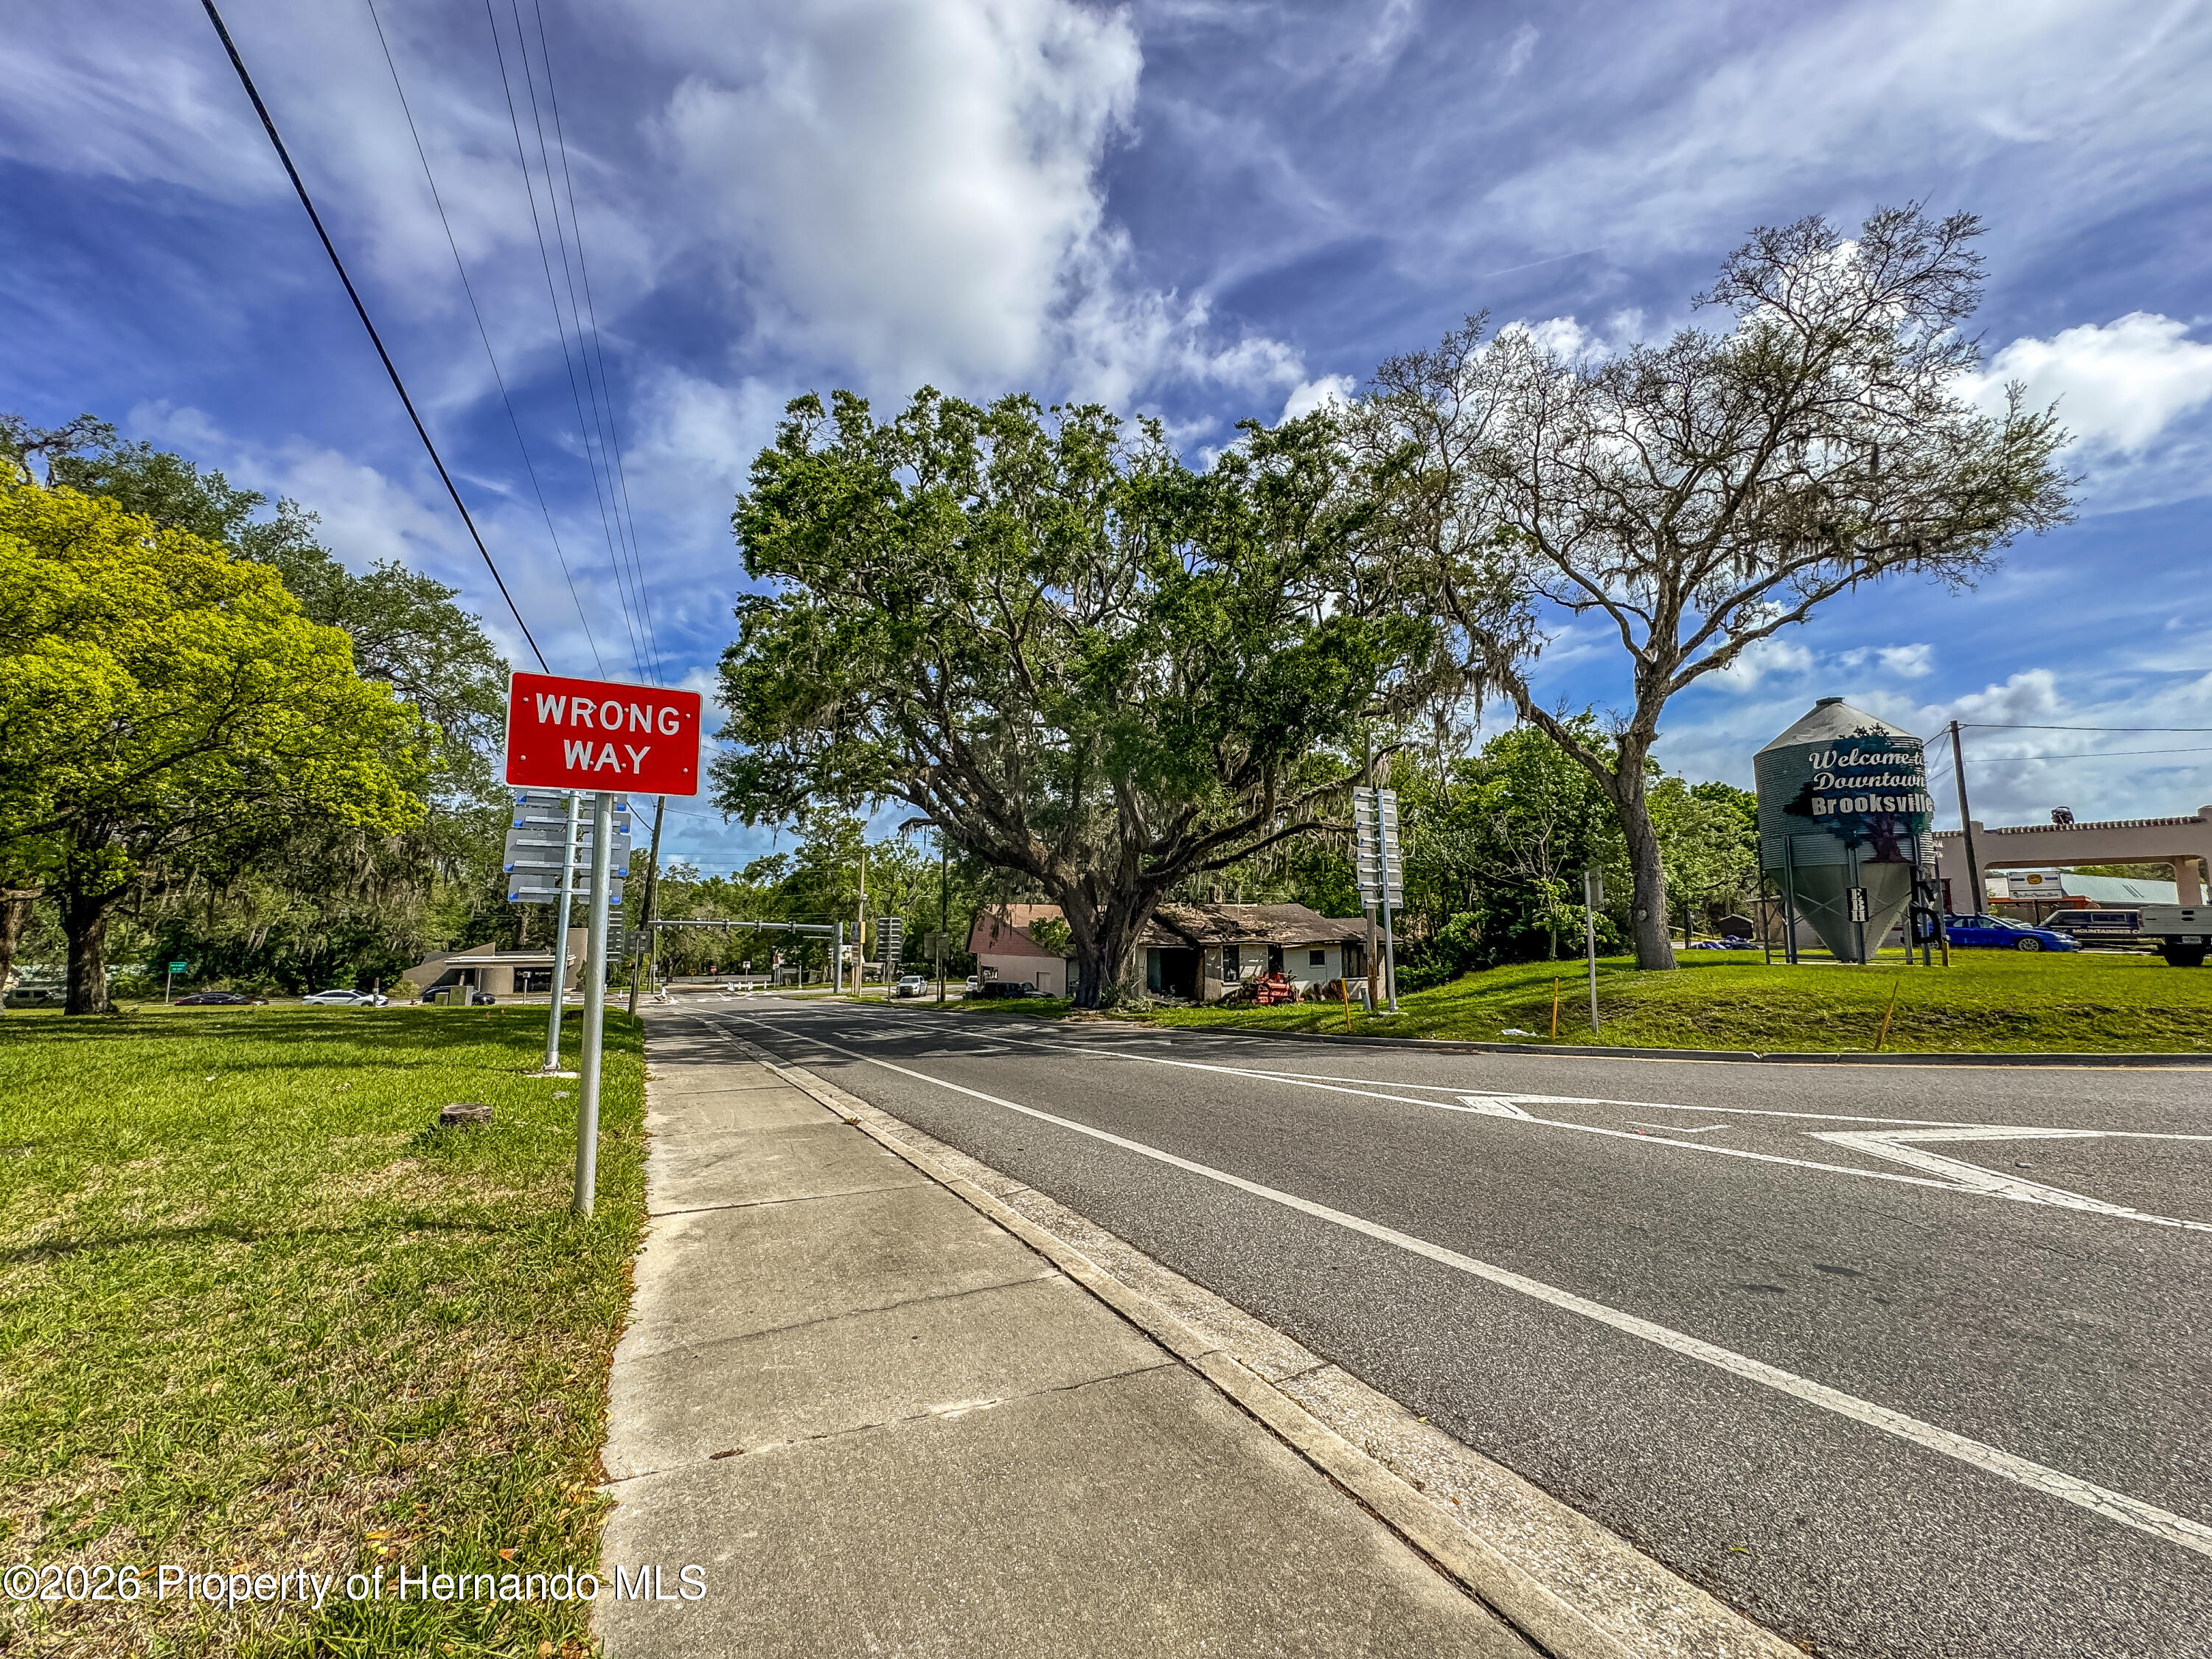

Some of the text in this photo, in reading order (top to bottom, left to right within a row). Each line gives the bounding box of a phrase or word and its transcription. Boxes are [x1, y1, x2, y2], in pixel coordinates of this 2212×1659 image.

[536, 692, 680, 735] WRONG
[563, 740, 651, 774] WAY
[1809, 748, 1909, 769] Welcome
[1812, 772, 1925, 790] Downtown
[1812, 793, 1934, 815] Brooksville
